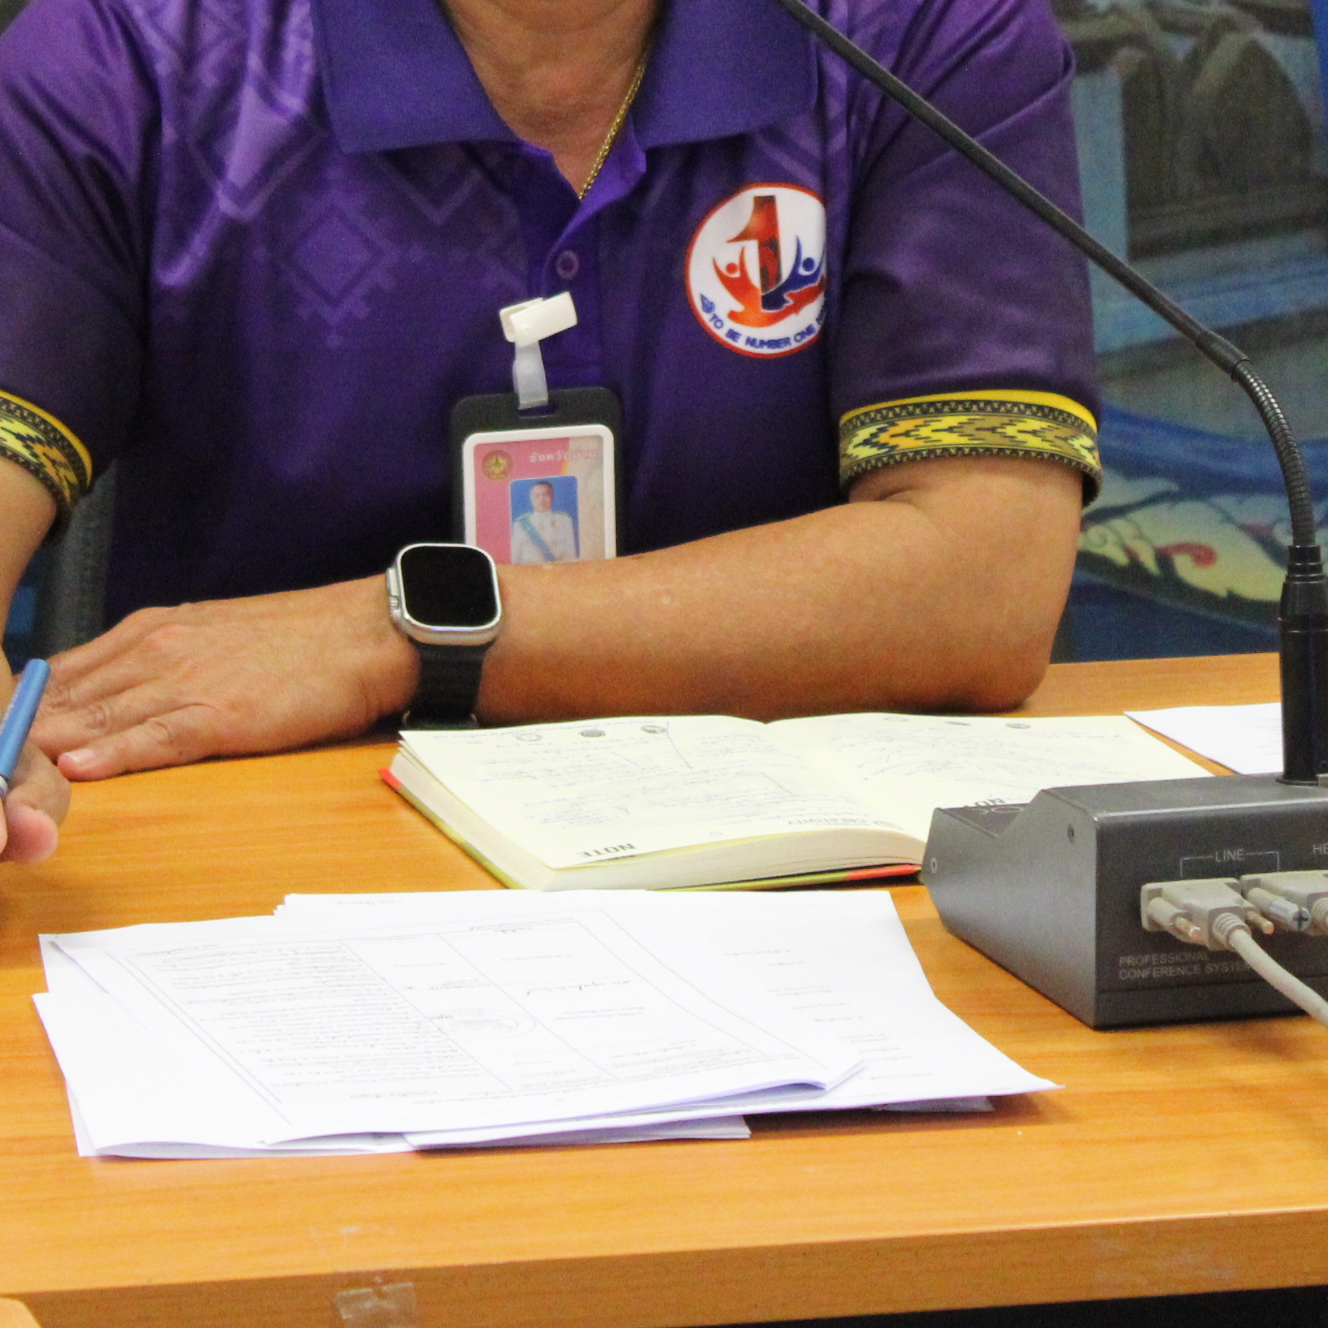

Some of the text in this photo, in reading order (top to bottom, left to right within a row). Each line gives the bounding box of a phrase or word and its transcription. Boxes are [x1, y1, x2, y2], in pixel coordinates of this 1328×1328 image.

[710, 313, 817, 349] TO BE NUMBER ONE
[576, 842, 637, 859] NOTE
[1215, 848, 1245, 863] LINE
[1118, 952, 1210, 967] PROFESSIONAL
[1118, 964, 1202, 980] CONFERENCE
